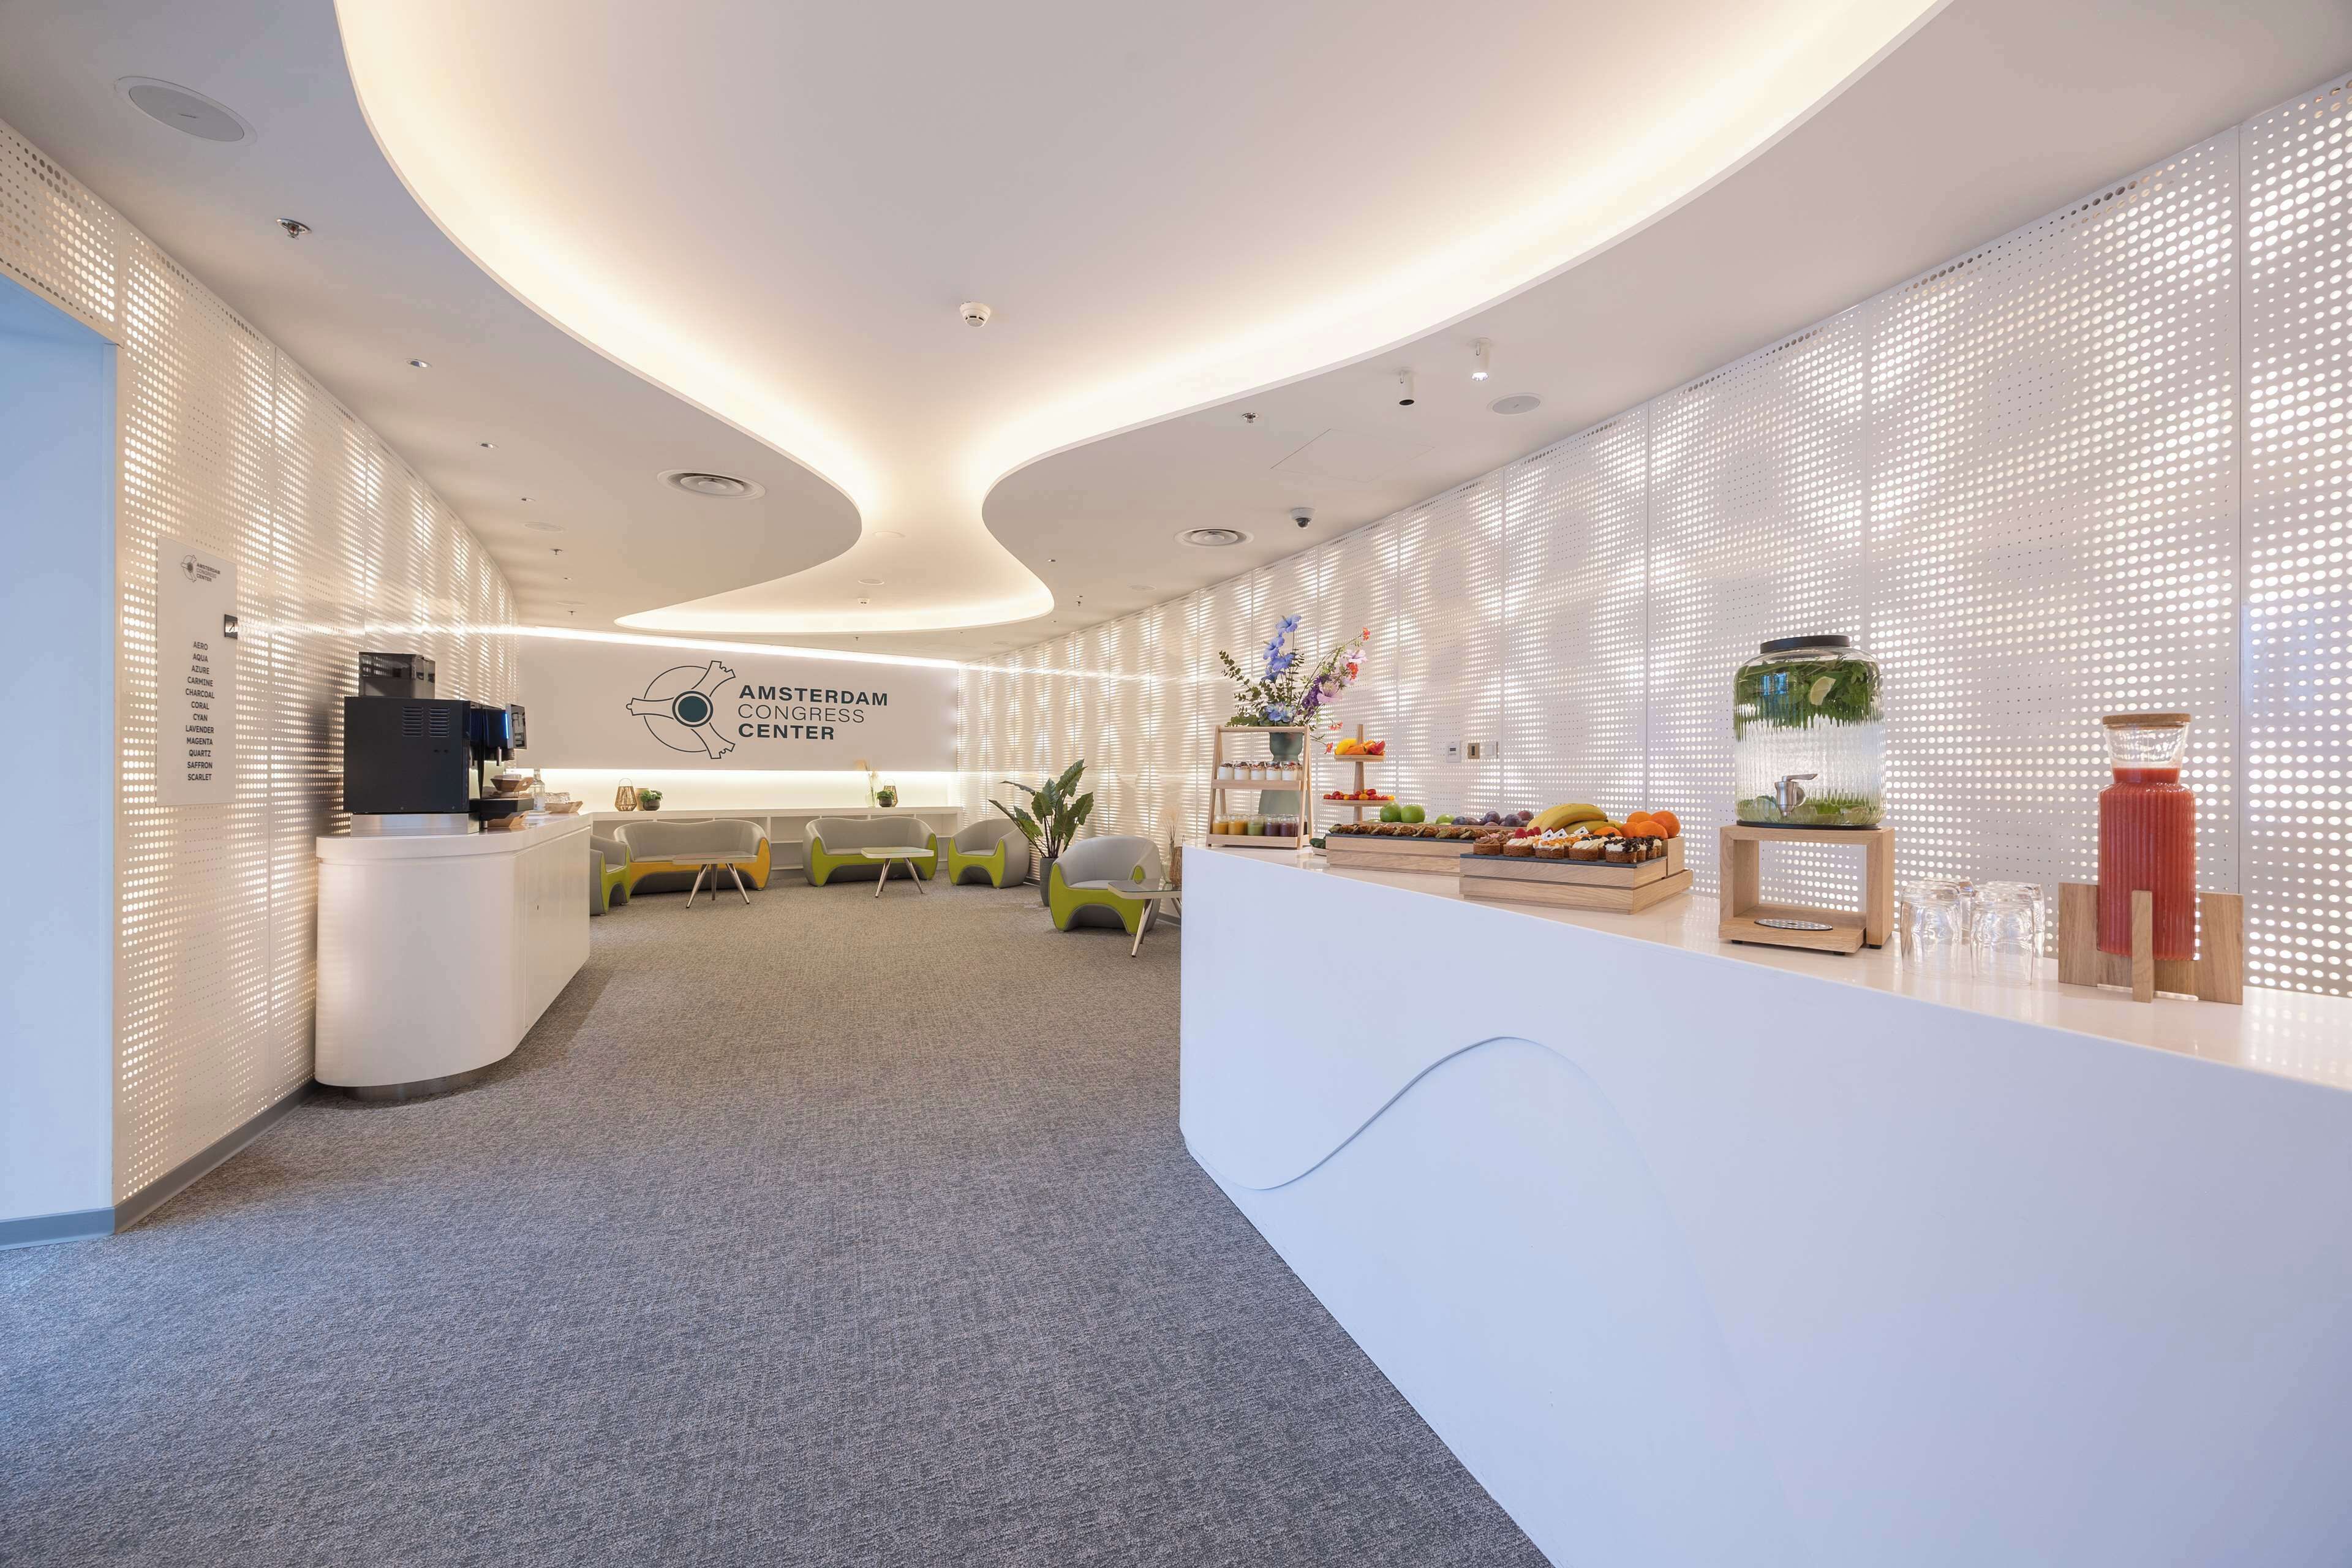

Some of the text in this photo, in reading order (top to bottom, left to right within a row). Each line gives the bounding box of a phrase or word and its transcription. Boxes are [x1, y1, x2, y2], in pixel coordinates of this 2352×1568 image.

[196, 573, 212, 582] CENTER
[193, 641, 208, 651] AERO
[192, 653, 208, 663] AQUA
[191, 665, 210, 675] AZURE
[187, 676, 213, 687] CARMINE
[185, 688, 215, 699] CHARCOAL
[739, 685, 888, 706] AMSTERDAM
[190, 701, 210, 710] CORAL
[192, 713, 208, 722] CYAN
[737, 703, 865, 723] CONGRESS
[185, 725, 214, 734] LAVENDER
[738, 723, 835, 741] CENTER
[186, 737, 213, 746] MAGENTA
[189, 749, 211, 758] QUARTZ
